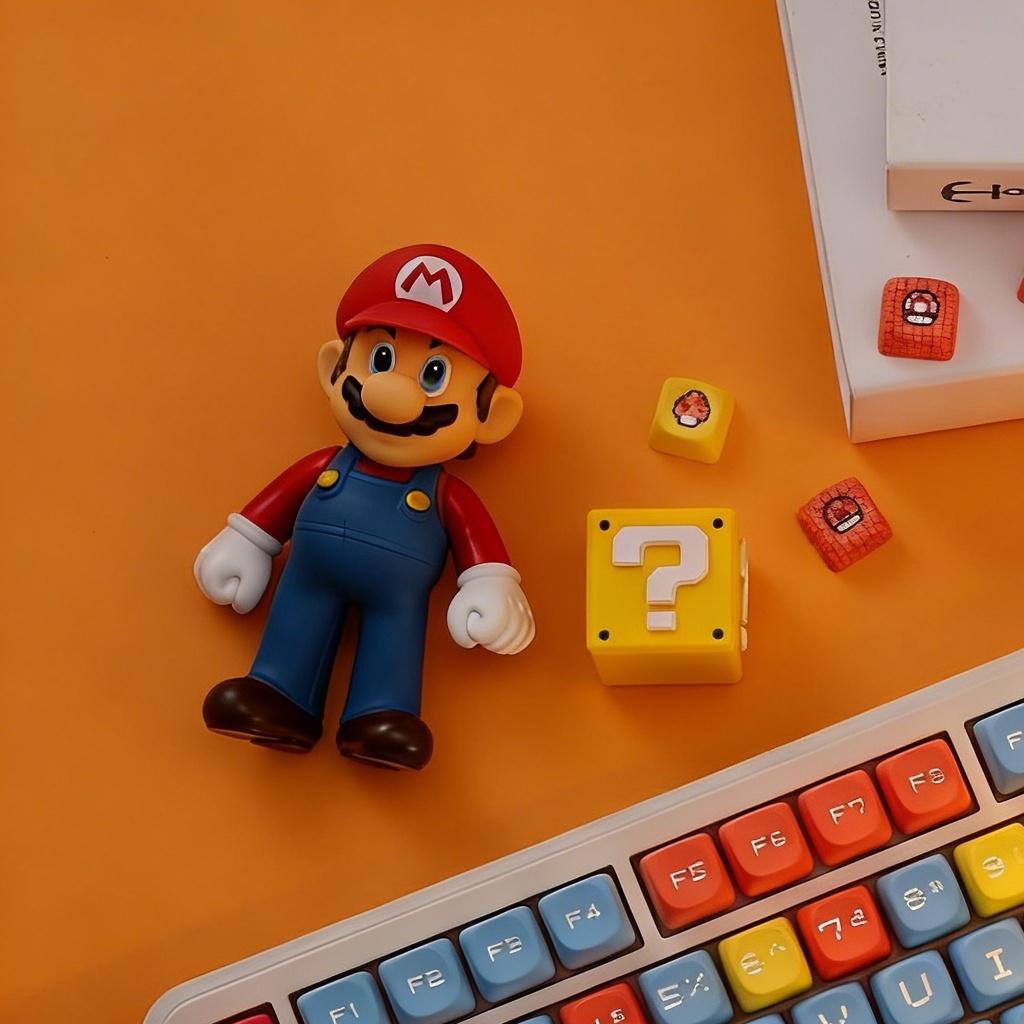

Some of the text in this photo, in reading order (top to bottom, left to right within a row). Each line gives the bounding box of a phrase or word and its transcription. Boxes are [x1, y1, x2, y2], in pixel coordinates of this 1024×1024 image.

[400, 263, 454, 305] M
[750, 830, 787, 857] F6
[670, 860, 707, 890] F5
[565, 903, 601, 930] F4
[985, 947, 1012, 982] I
[406, 969, 445, 995] F2
[898, 972, 934, 1008] U
